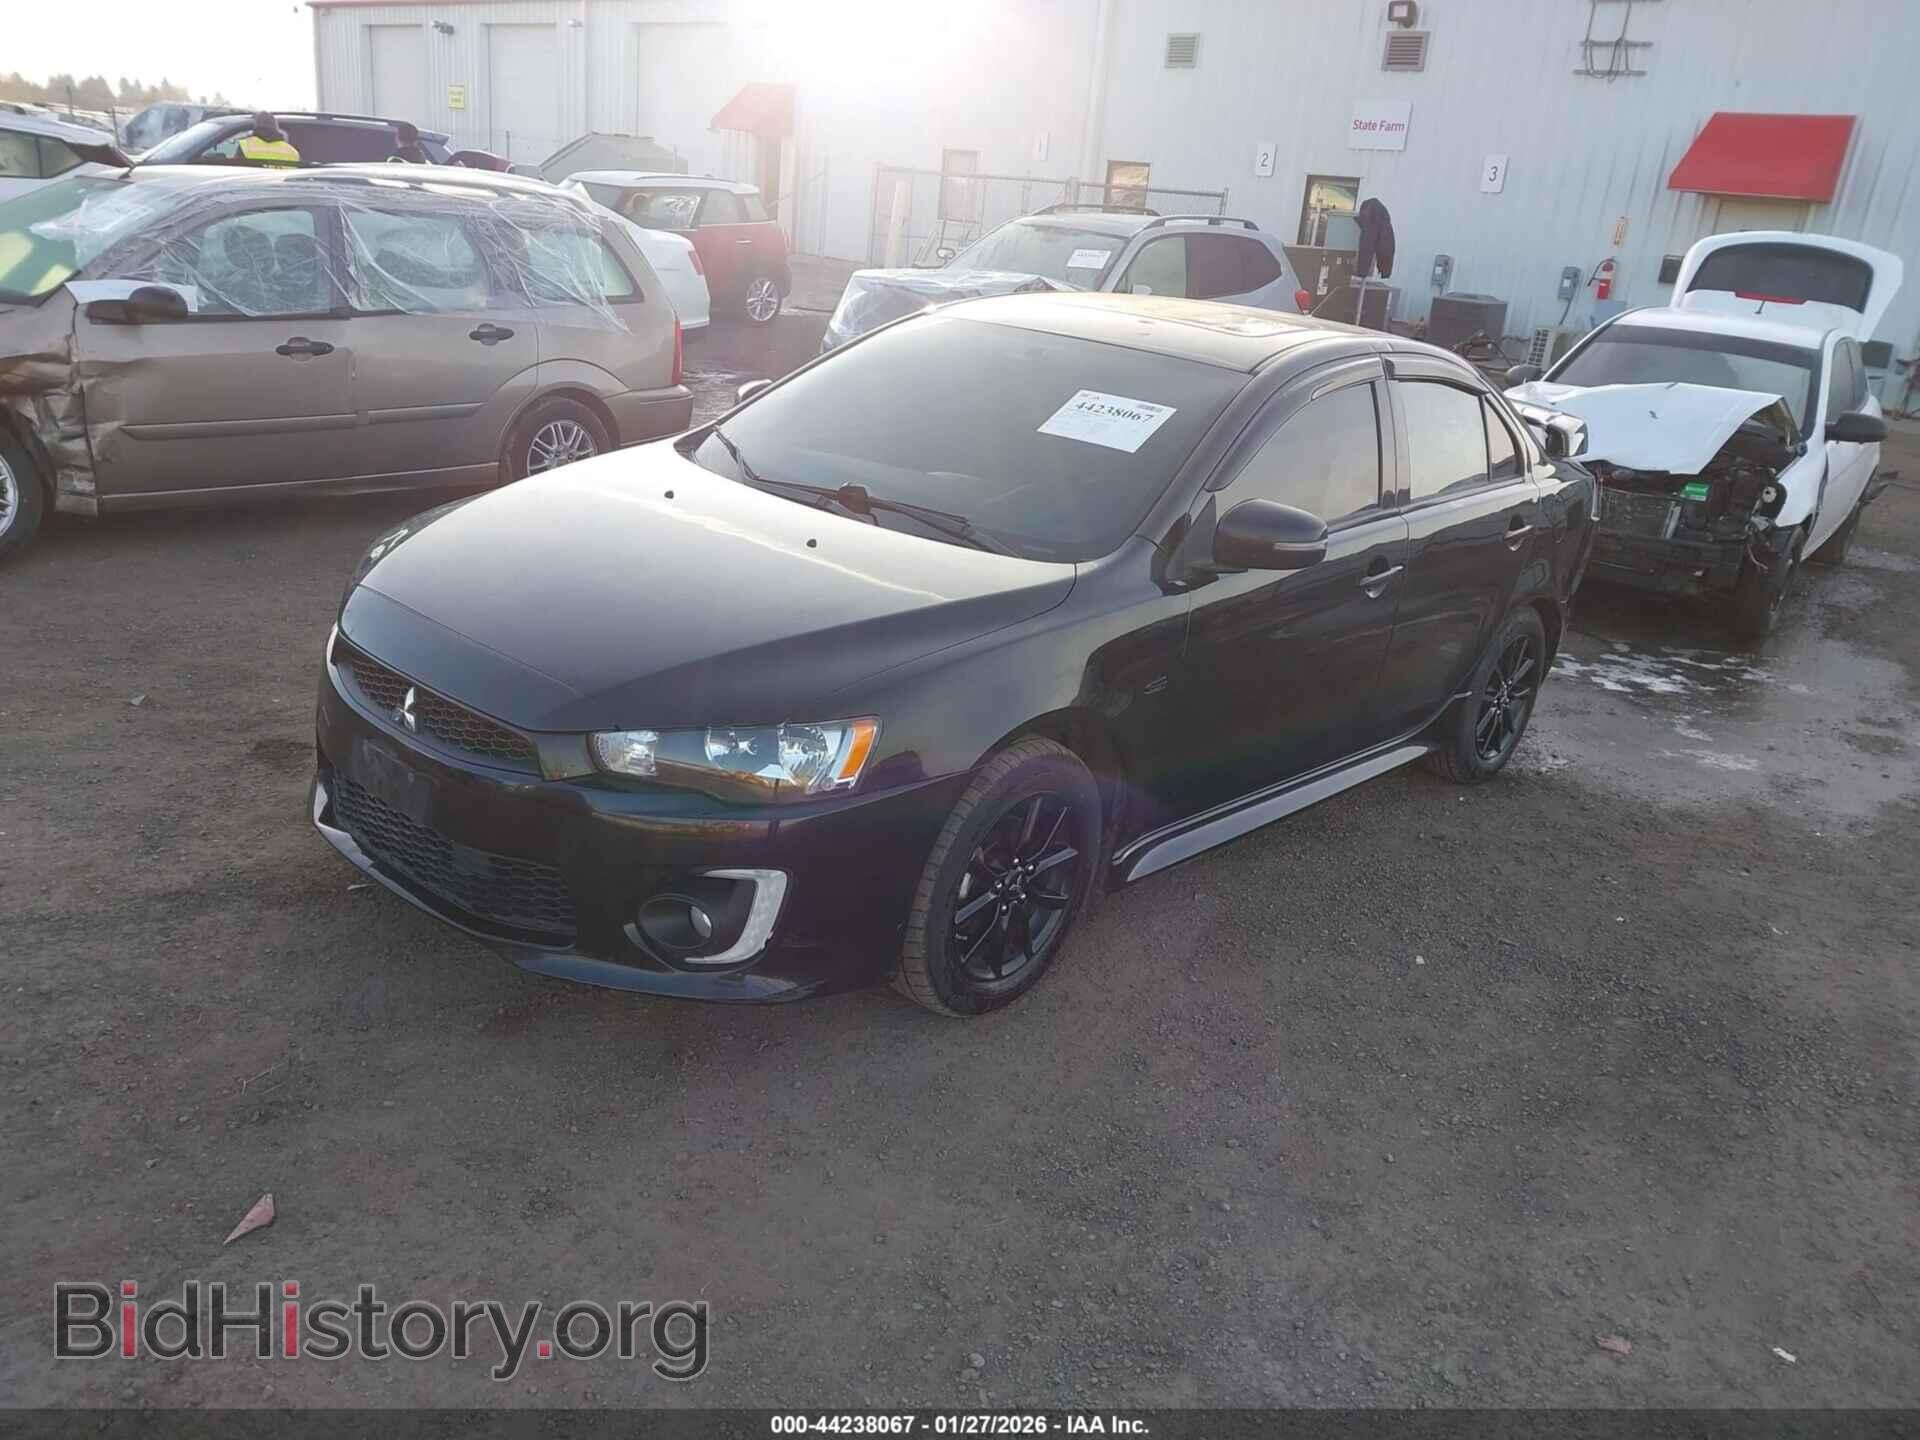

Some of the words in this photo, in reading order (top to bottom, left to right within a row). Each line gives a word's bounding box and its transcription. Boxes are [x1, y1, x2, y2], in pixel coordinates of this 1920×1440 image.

[1353, 119, 1377, 131] State
[1379, 119, 1405, 132] Farm
[1260, 152, 1269, 167] 2
[1488, 165, 1498, 182] 3
[1076, 401, 1154, 423] 44238067
